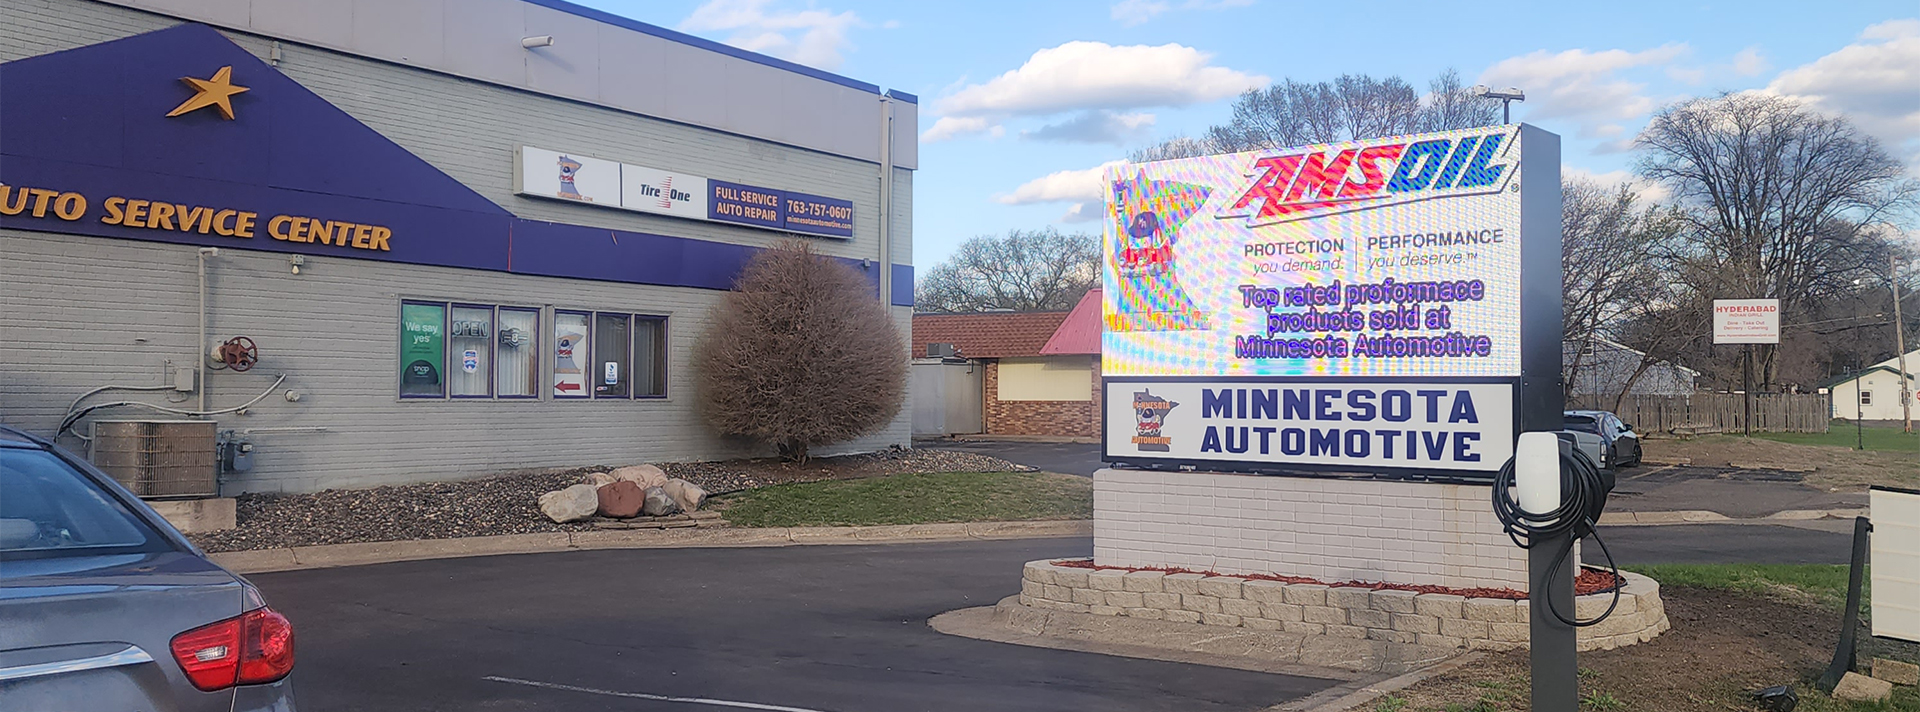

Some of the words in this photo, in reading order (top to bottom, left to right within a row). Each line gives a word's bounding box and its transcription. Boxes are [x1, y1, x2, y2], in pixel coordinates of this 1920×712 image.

[1231, 133, 1507, 218] AMSOIL
[640, 184, 660, 197] Tire
[670, 188, 691, 202] One
[715, 186, 739, 201] FULL
[740, 190, 778, 207] SERVICE
[0, 185, 87, 221] UTO
[101, 196, 257, 238] SERVICE
[267, 214, 392, 251] CENTER
[716, 202, 742, 217] AUTO
[744, 206, 777, 222] REPAIR
[786, 200, 852, 220] 763-757-0607
[1244, 238, 1345, 257] PROTECTION
[1367, 229, 1504, 250] PERFORMANCE
[1253, 261, 1278, 275] you
[1282, 256, 1344, 273] demand.
[1368, 252, 1394, 269] you
[1238, 284, 1279, 312] Top
[1284, 280, 1341, 307] rated
[1345, 277, 1485, 308] proformace
[1716, 305, 1777, 313] HYDERABAD
[405, 321, 420, 332] We
[422, 323, 438, 335] say
[452, 321, 489, 338] OPEN
[1267, 306, 1364, 338] products
[1369, 304, 1420, 331] sold
[1425, 304, 1451, 330] at
[413, 334, 430, 344] yes
[1235, 335, 1348, 359] Minnesota
[1353, 332, 1492, 358] Automotive
[1132, 401, 1171, 409] MNNESOTA
[1201, 388, 1480, 424] MINNESOTA
[1199, 425, 1482, 462] AUTOMOTIVE
